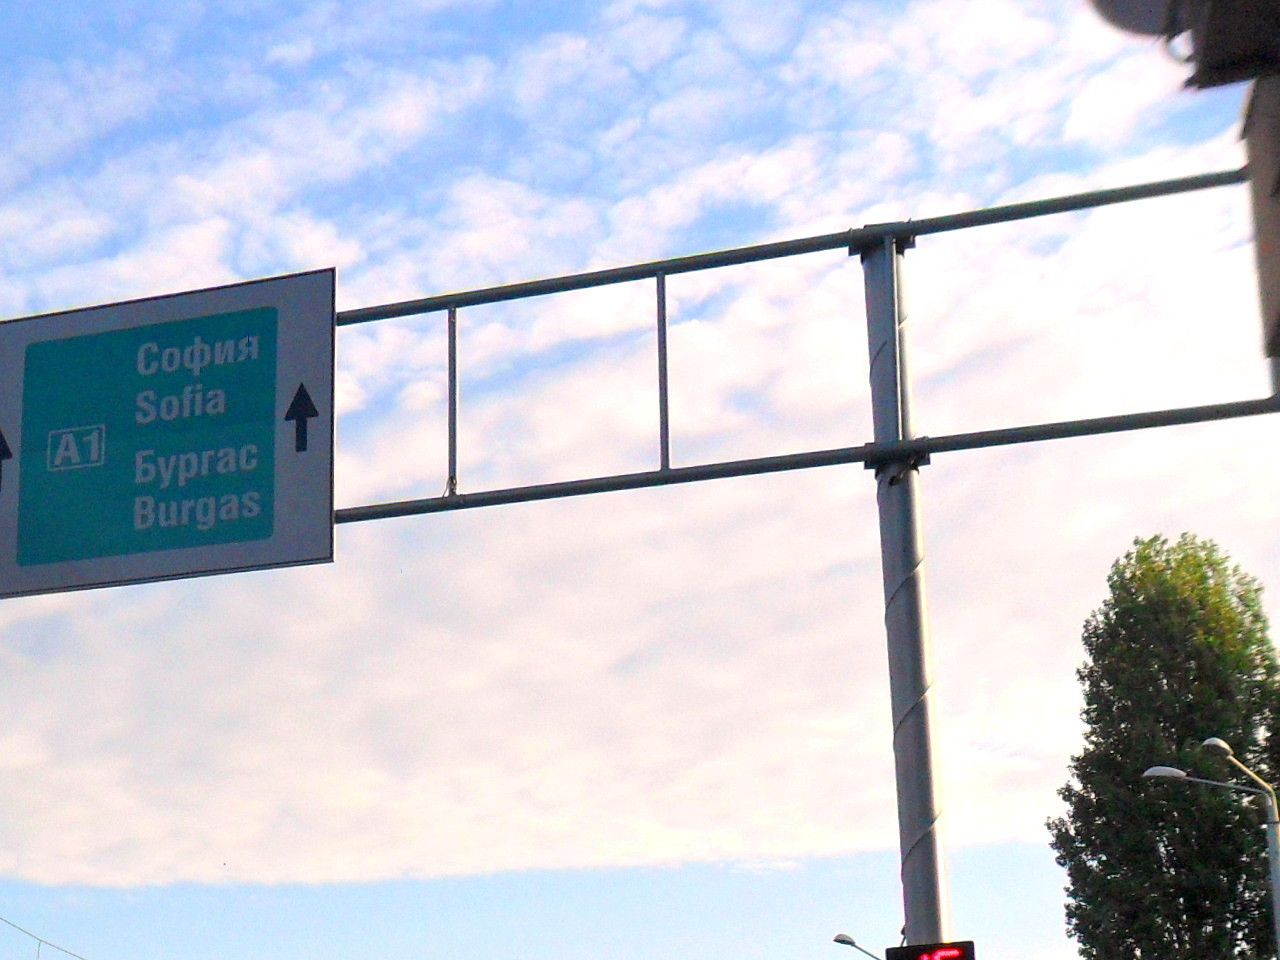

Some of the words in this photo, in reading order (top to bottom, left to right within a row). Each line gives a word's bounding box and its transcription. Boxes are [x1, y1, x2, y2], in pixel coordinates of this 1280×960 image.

[136, 334, 260, 376] София
[134, 383, 227, 424] Sofia
[52, 430, 102, 467] A1
[134, 443, 259, 489] Бургас
[132, 490, 262, 530] Burgas
